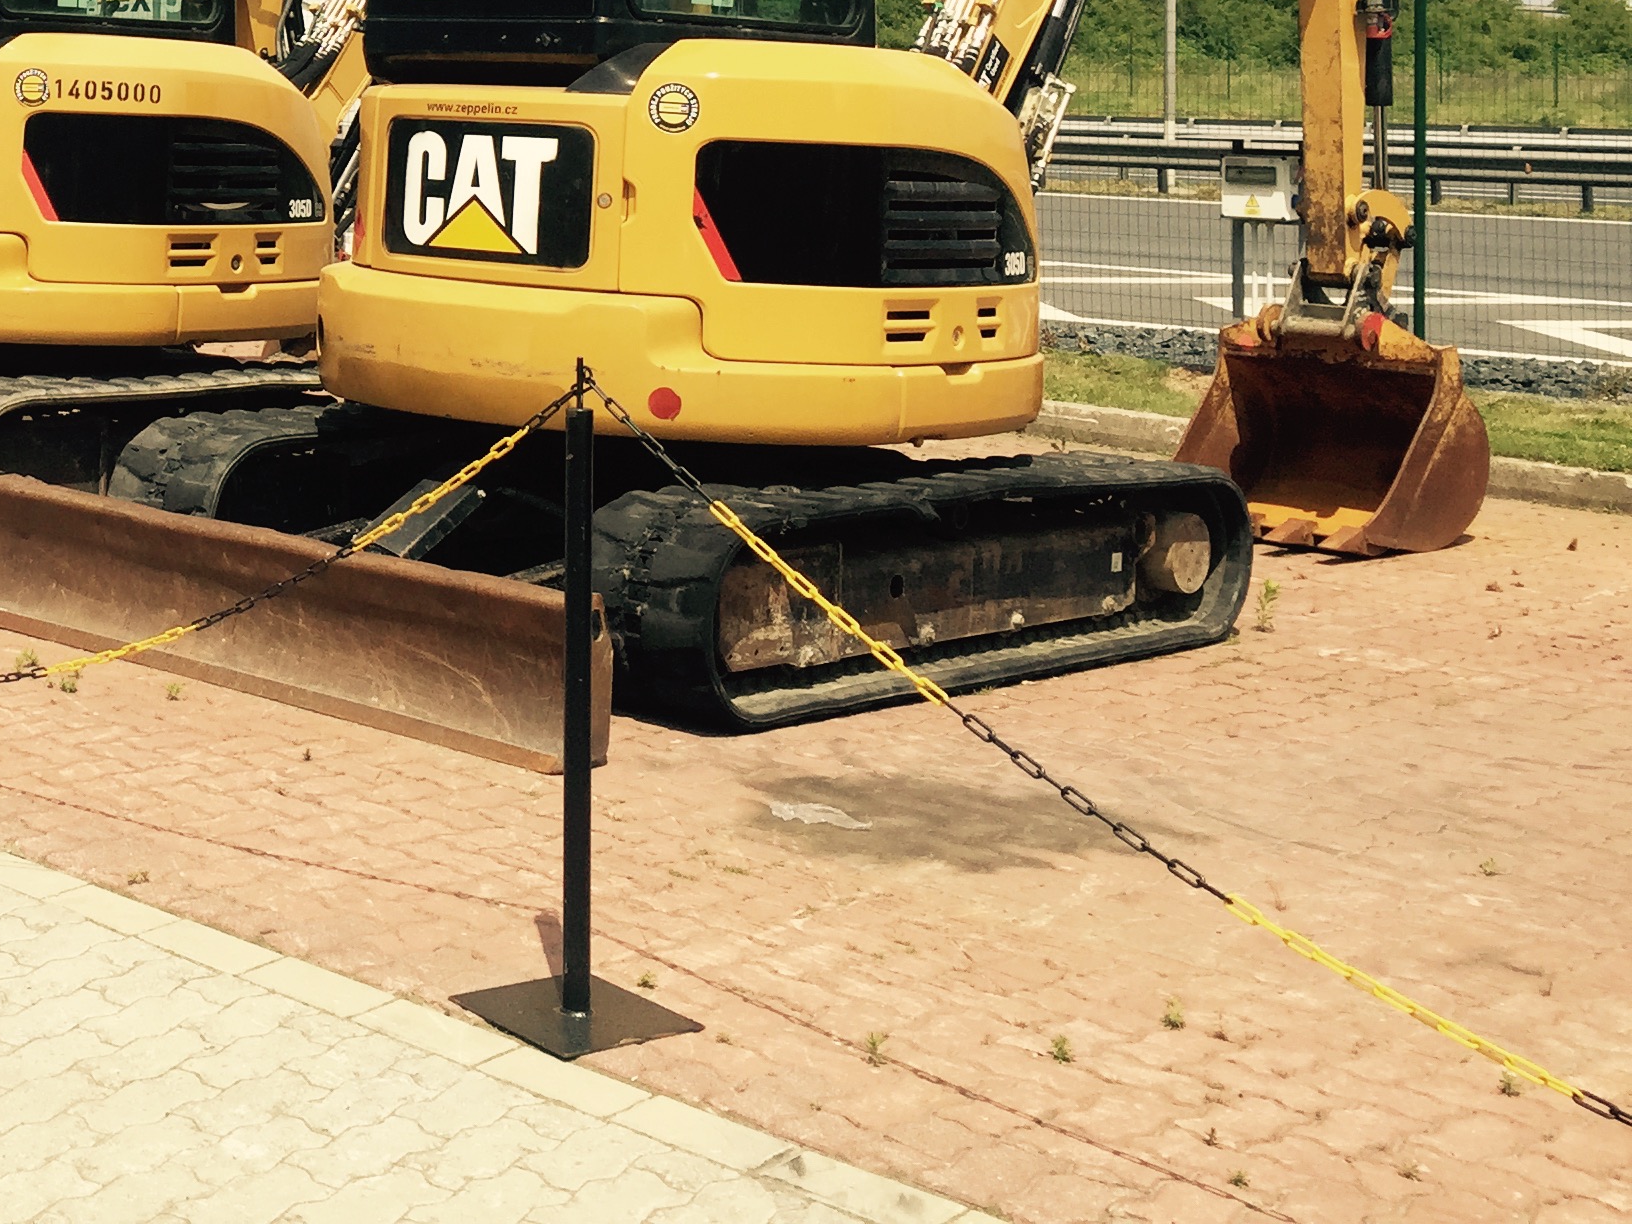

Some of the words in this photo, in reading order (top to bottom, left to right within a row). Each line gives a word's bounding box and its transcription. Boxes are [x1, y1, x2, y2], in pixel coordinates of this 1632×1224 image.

[427, 97, 518, 116] www.zeppelin.cz
[403, 130, 559, 255] CAT
[288, 198, 313, 218] 305D
[1004, 251, 1026, 276] 305D
